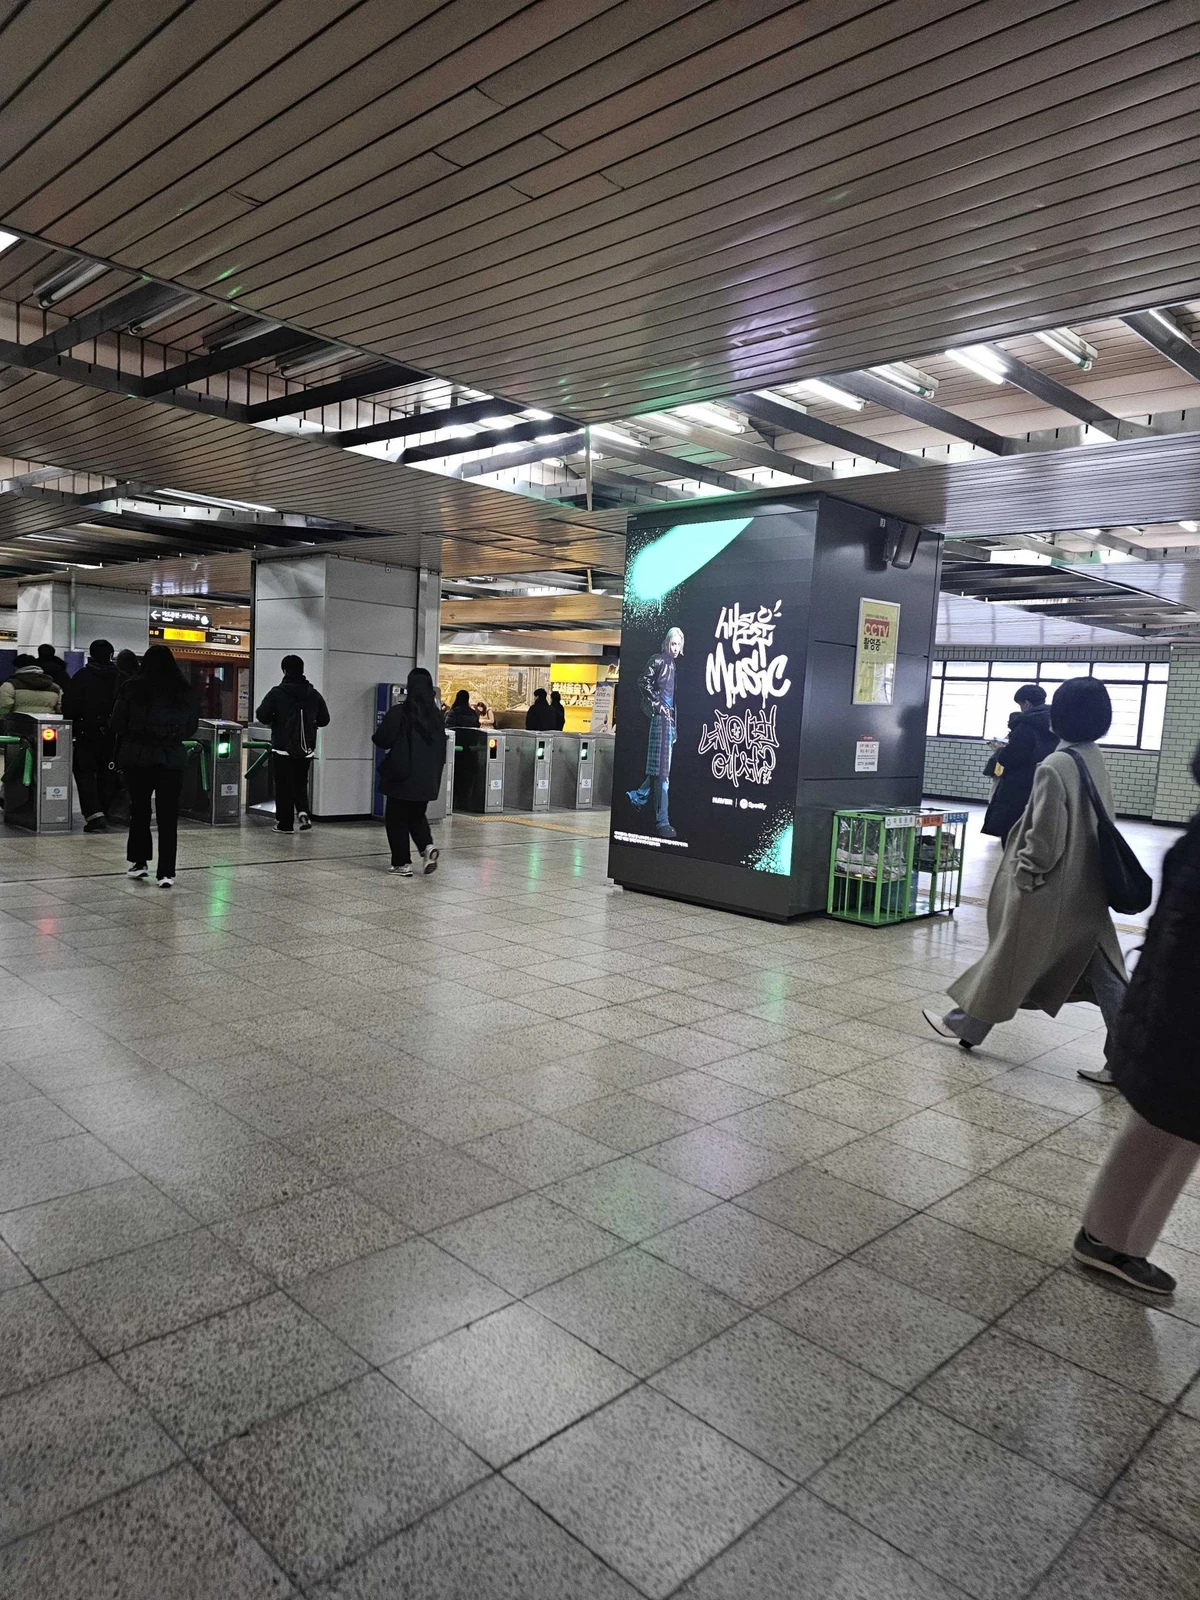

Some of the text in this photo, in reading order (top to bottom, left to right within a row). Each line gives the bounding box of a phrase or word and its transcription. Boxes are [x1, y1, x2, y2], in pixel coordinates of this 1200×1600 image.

[864, 622, 889, 637] CCTV
[863, 637, 881, 651] 촬영중
[712, 796, 767, 811] NAVER Spotify
